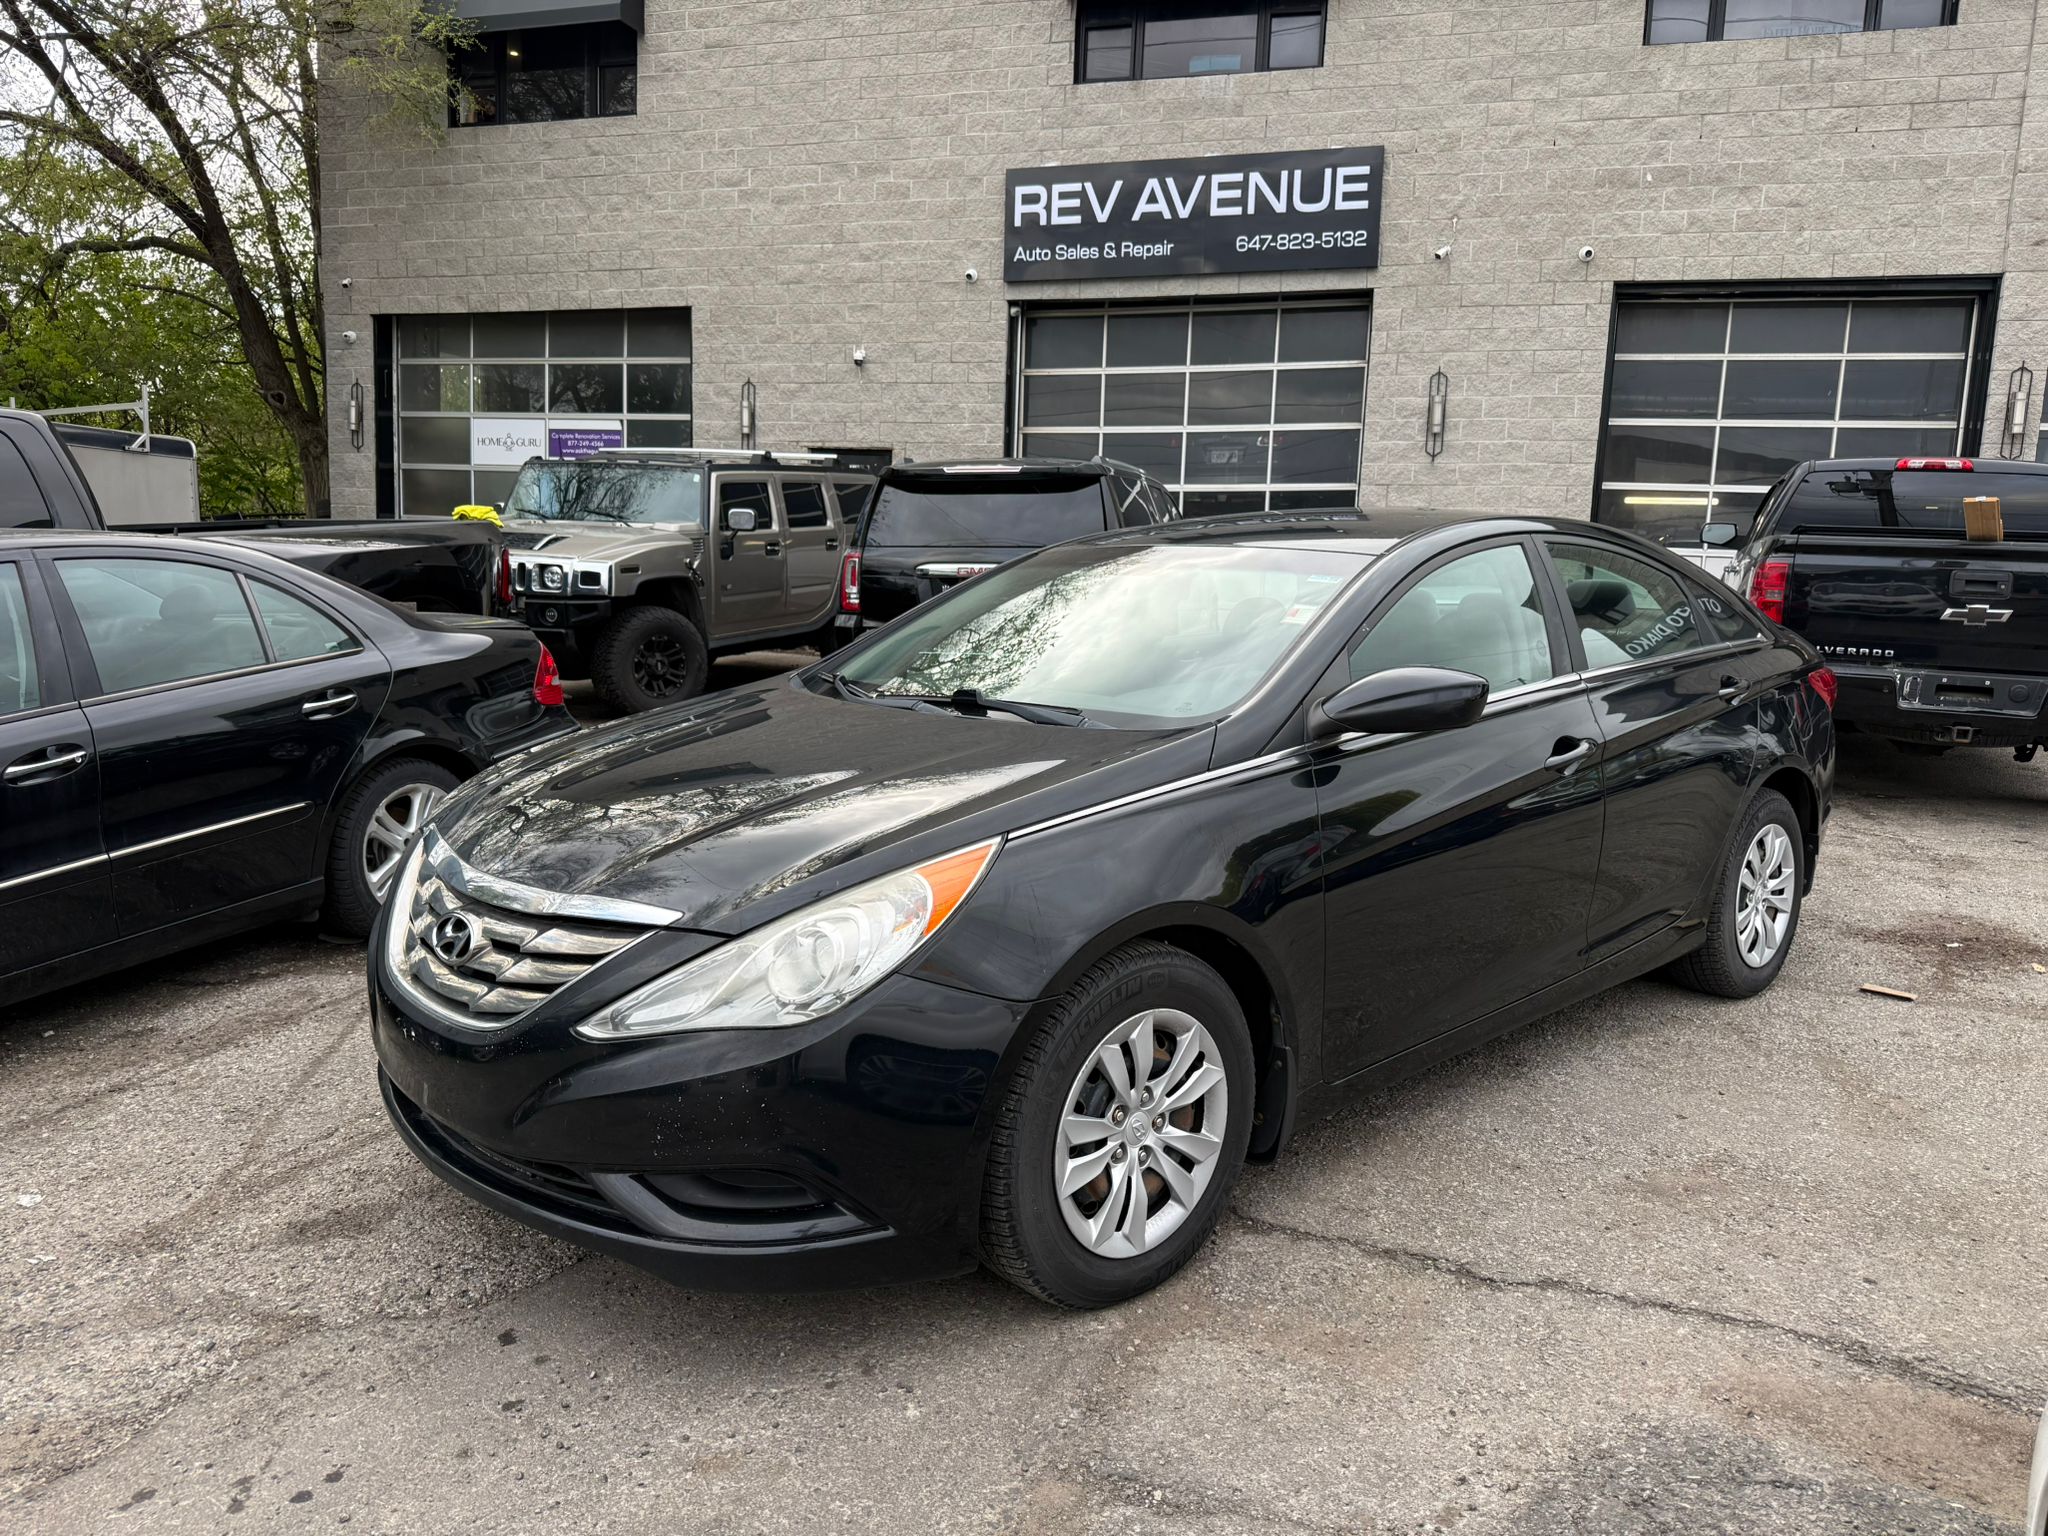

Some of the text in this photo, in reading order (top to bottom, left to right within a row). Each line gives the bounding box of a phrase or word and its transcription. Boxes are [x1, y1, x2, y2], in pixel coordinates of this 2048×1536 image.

[1014, 165, 1371, 227] REV AVENUE
[1236, 230, 1367, 252] 647-823-5132
[1014, 240, 1174, 262] Auto Sales & Repair
[551, 432, 574, 440] Complete
[477, 437, 542, 448] HOME GURU
[957, 567, 991, 577] GM
[1816, 645, 1894, 657] LVERADO
